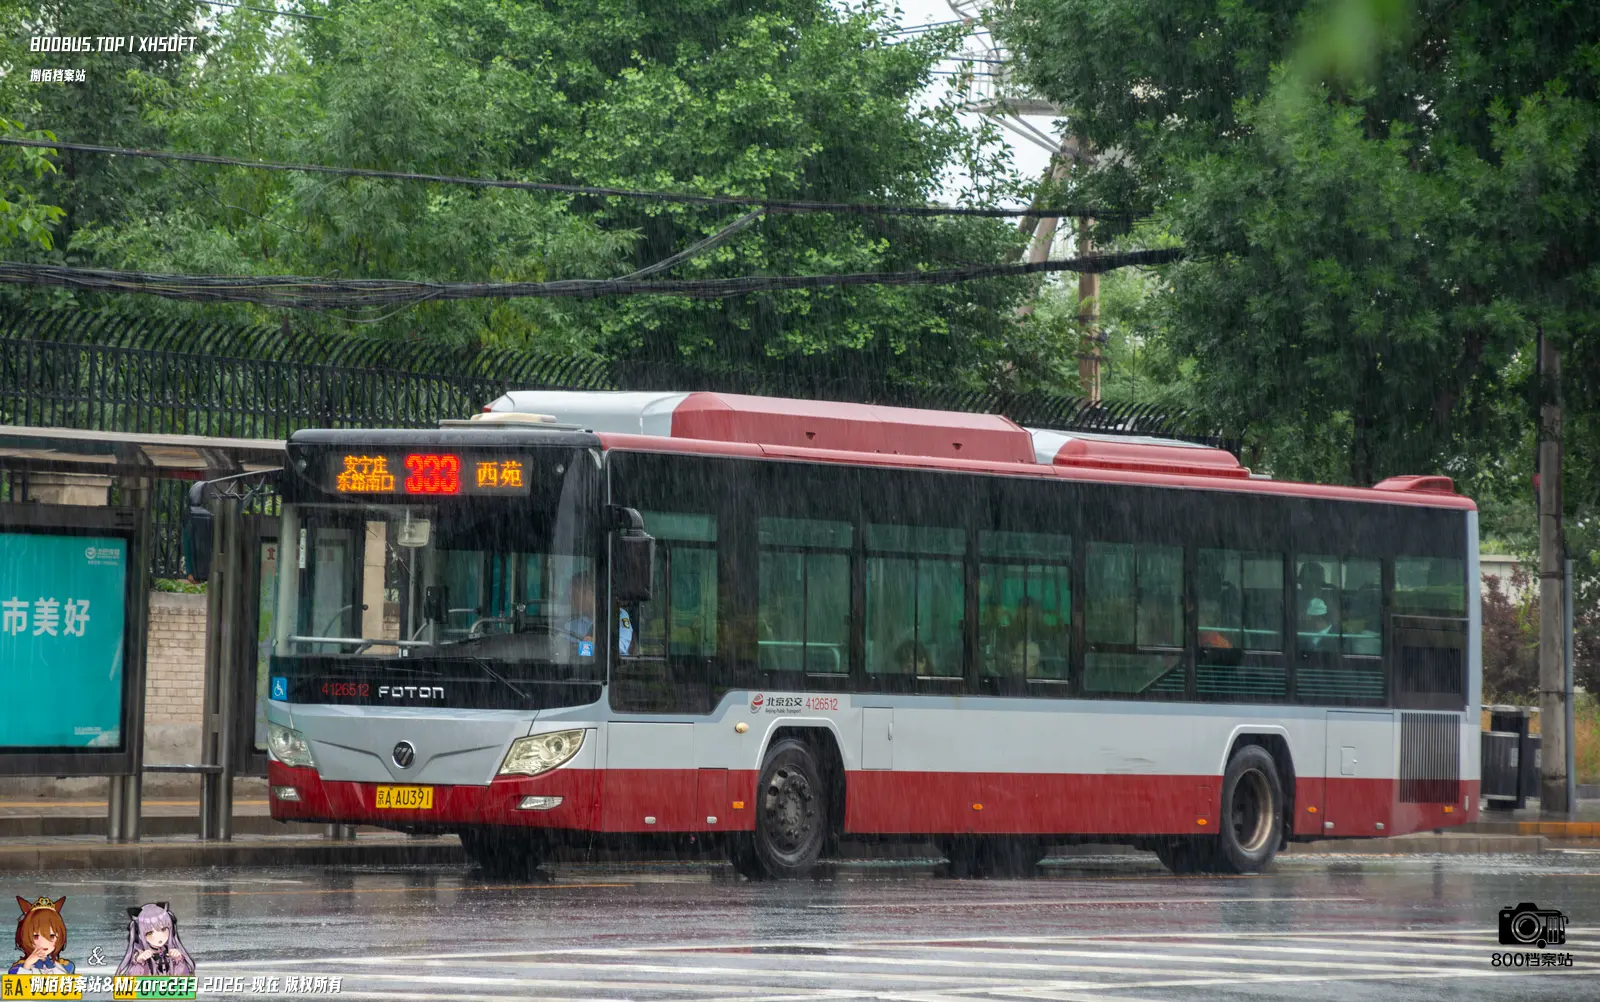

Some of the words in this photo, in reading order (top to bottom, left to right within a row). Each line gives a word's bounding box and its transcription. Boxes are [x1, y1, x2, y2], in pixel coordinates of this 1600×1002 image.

[343, 455, 388, 474] 安宁庄
[476, 460, 523, 487] 西苑
[336, 473, 395, 491] 东路南口
[405, 454, 460, 494] 333
[2, 596, 91, 637] 市美好
[321, 683, 370, 697] 4126512
[378, 685, 445, 699] FOTON
[766, 697, 803, 707] 北京公交
[805, 697, 838, 711] 4126512
